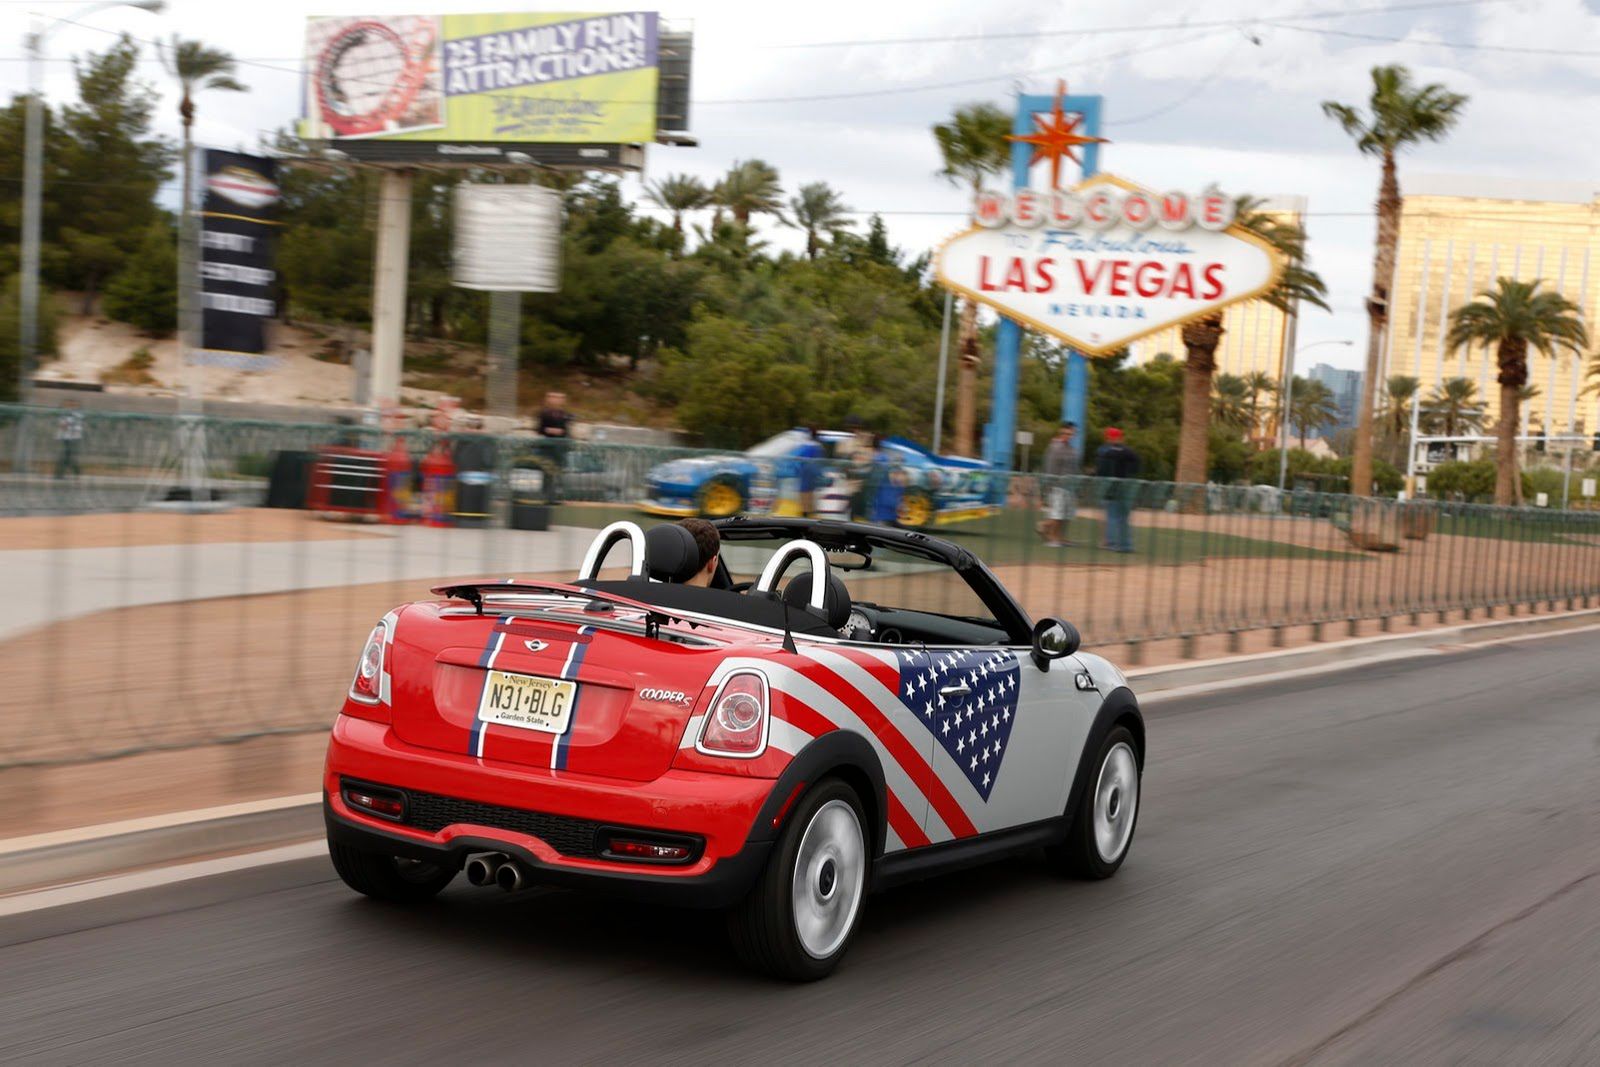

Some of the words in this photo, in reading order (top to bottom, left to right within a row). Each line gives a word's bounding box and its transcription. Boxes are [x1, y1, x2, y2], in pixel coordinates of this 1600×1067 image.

[446, 40, 477, 68] 25
[480, 23, 581, 63] FAMILY
[584, 13, 646, 48] FUN
[448, 41, 646, 94] ATTRACTIONS!
[976, 193, 1226, 225] WELCOME
[979, 255, 1056, 293] LAS
[1076, 258, 1226, 300] VEGAS
[1048, 303, 1147, 319] NEVADA
[509, 675, 528, 686] New
[528, 678, 552, 690] Jersey
[639, 688, 685, 702] COOPER
[678, 696, 693, 708] S
[500, 712, 525, 722] Garden
[526, 715, 545, 725] State
